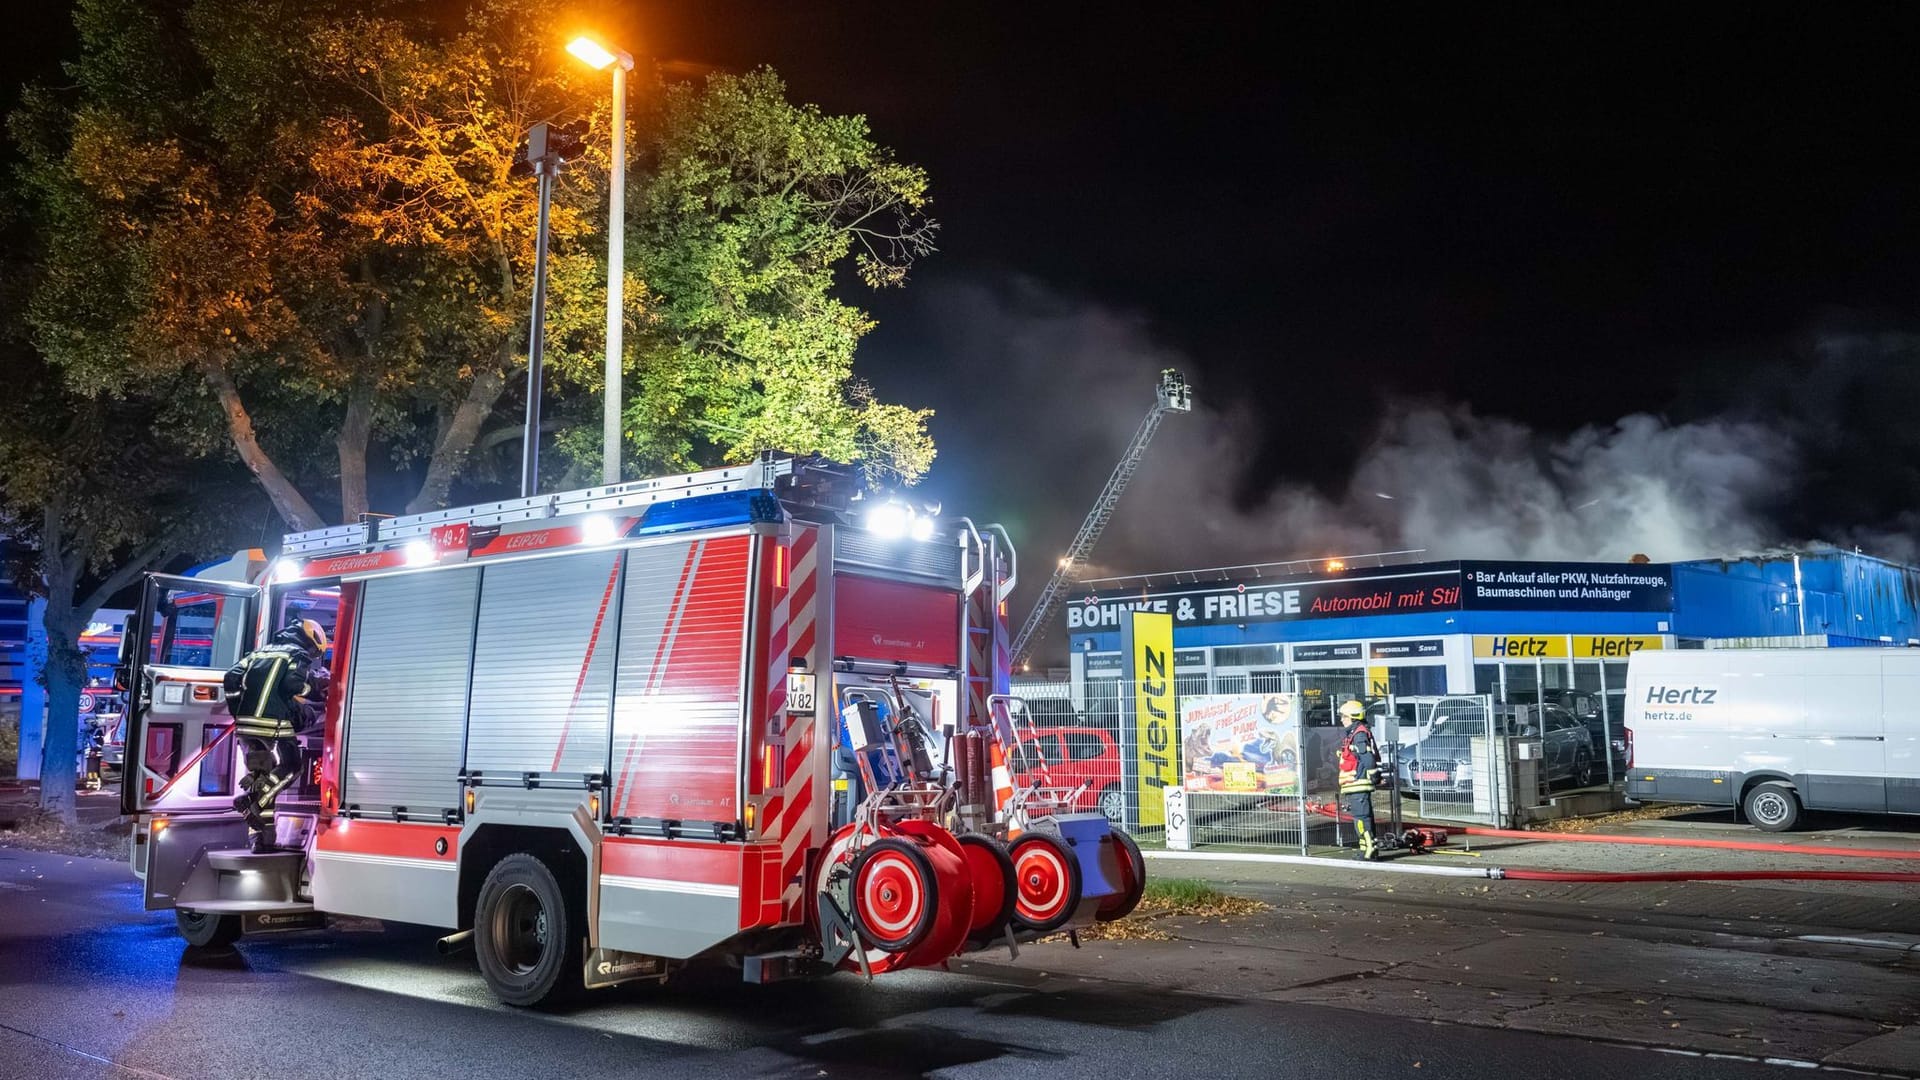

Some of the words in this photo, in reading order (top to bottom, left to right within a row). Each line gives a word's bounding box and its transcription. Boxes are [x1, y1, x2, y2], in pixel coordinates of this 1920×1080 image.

[506, 532, 549, 549] LEIPZIG
[328, 555, 382, 572] FEUERWEHR
[1476, 572, 1495, 583] Bar
[1497, 572, 1536, 583] Ankauf
[1537, 573, 1560, 584] aller
[1561, 573, 1590, 586] PKW,
[1591, 574, 1667, 587] Nutzfahrzeuge,
[1477, 586, 1556, 598] Baumaschinen
[1558, 587, 1579, 598] und
[1580, 588, 1631, 601] Anhänger
[1177, 597, 1196, 621] &
[1204, 588, 1301, 619] FRIESE
[1310, 591, 1392, 613] Automobil
[1398, 589, 1425, 607] mit
[1431, 586, 1460, 605] Stil
[1492, 637, 1548, 656] Hertz
[791, 676, 798, 692] L
[1646, 686, 1717, 704] Hertz
[1142, 645, 1169, 790] Hertz
[1644, 711, 1693, 721] hertz.de
